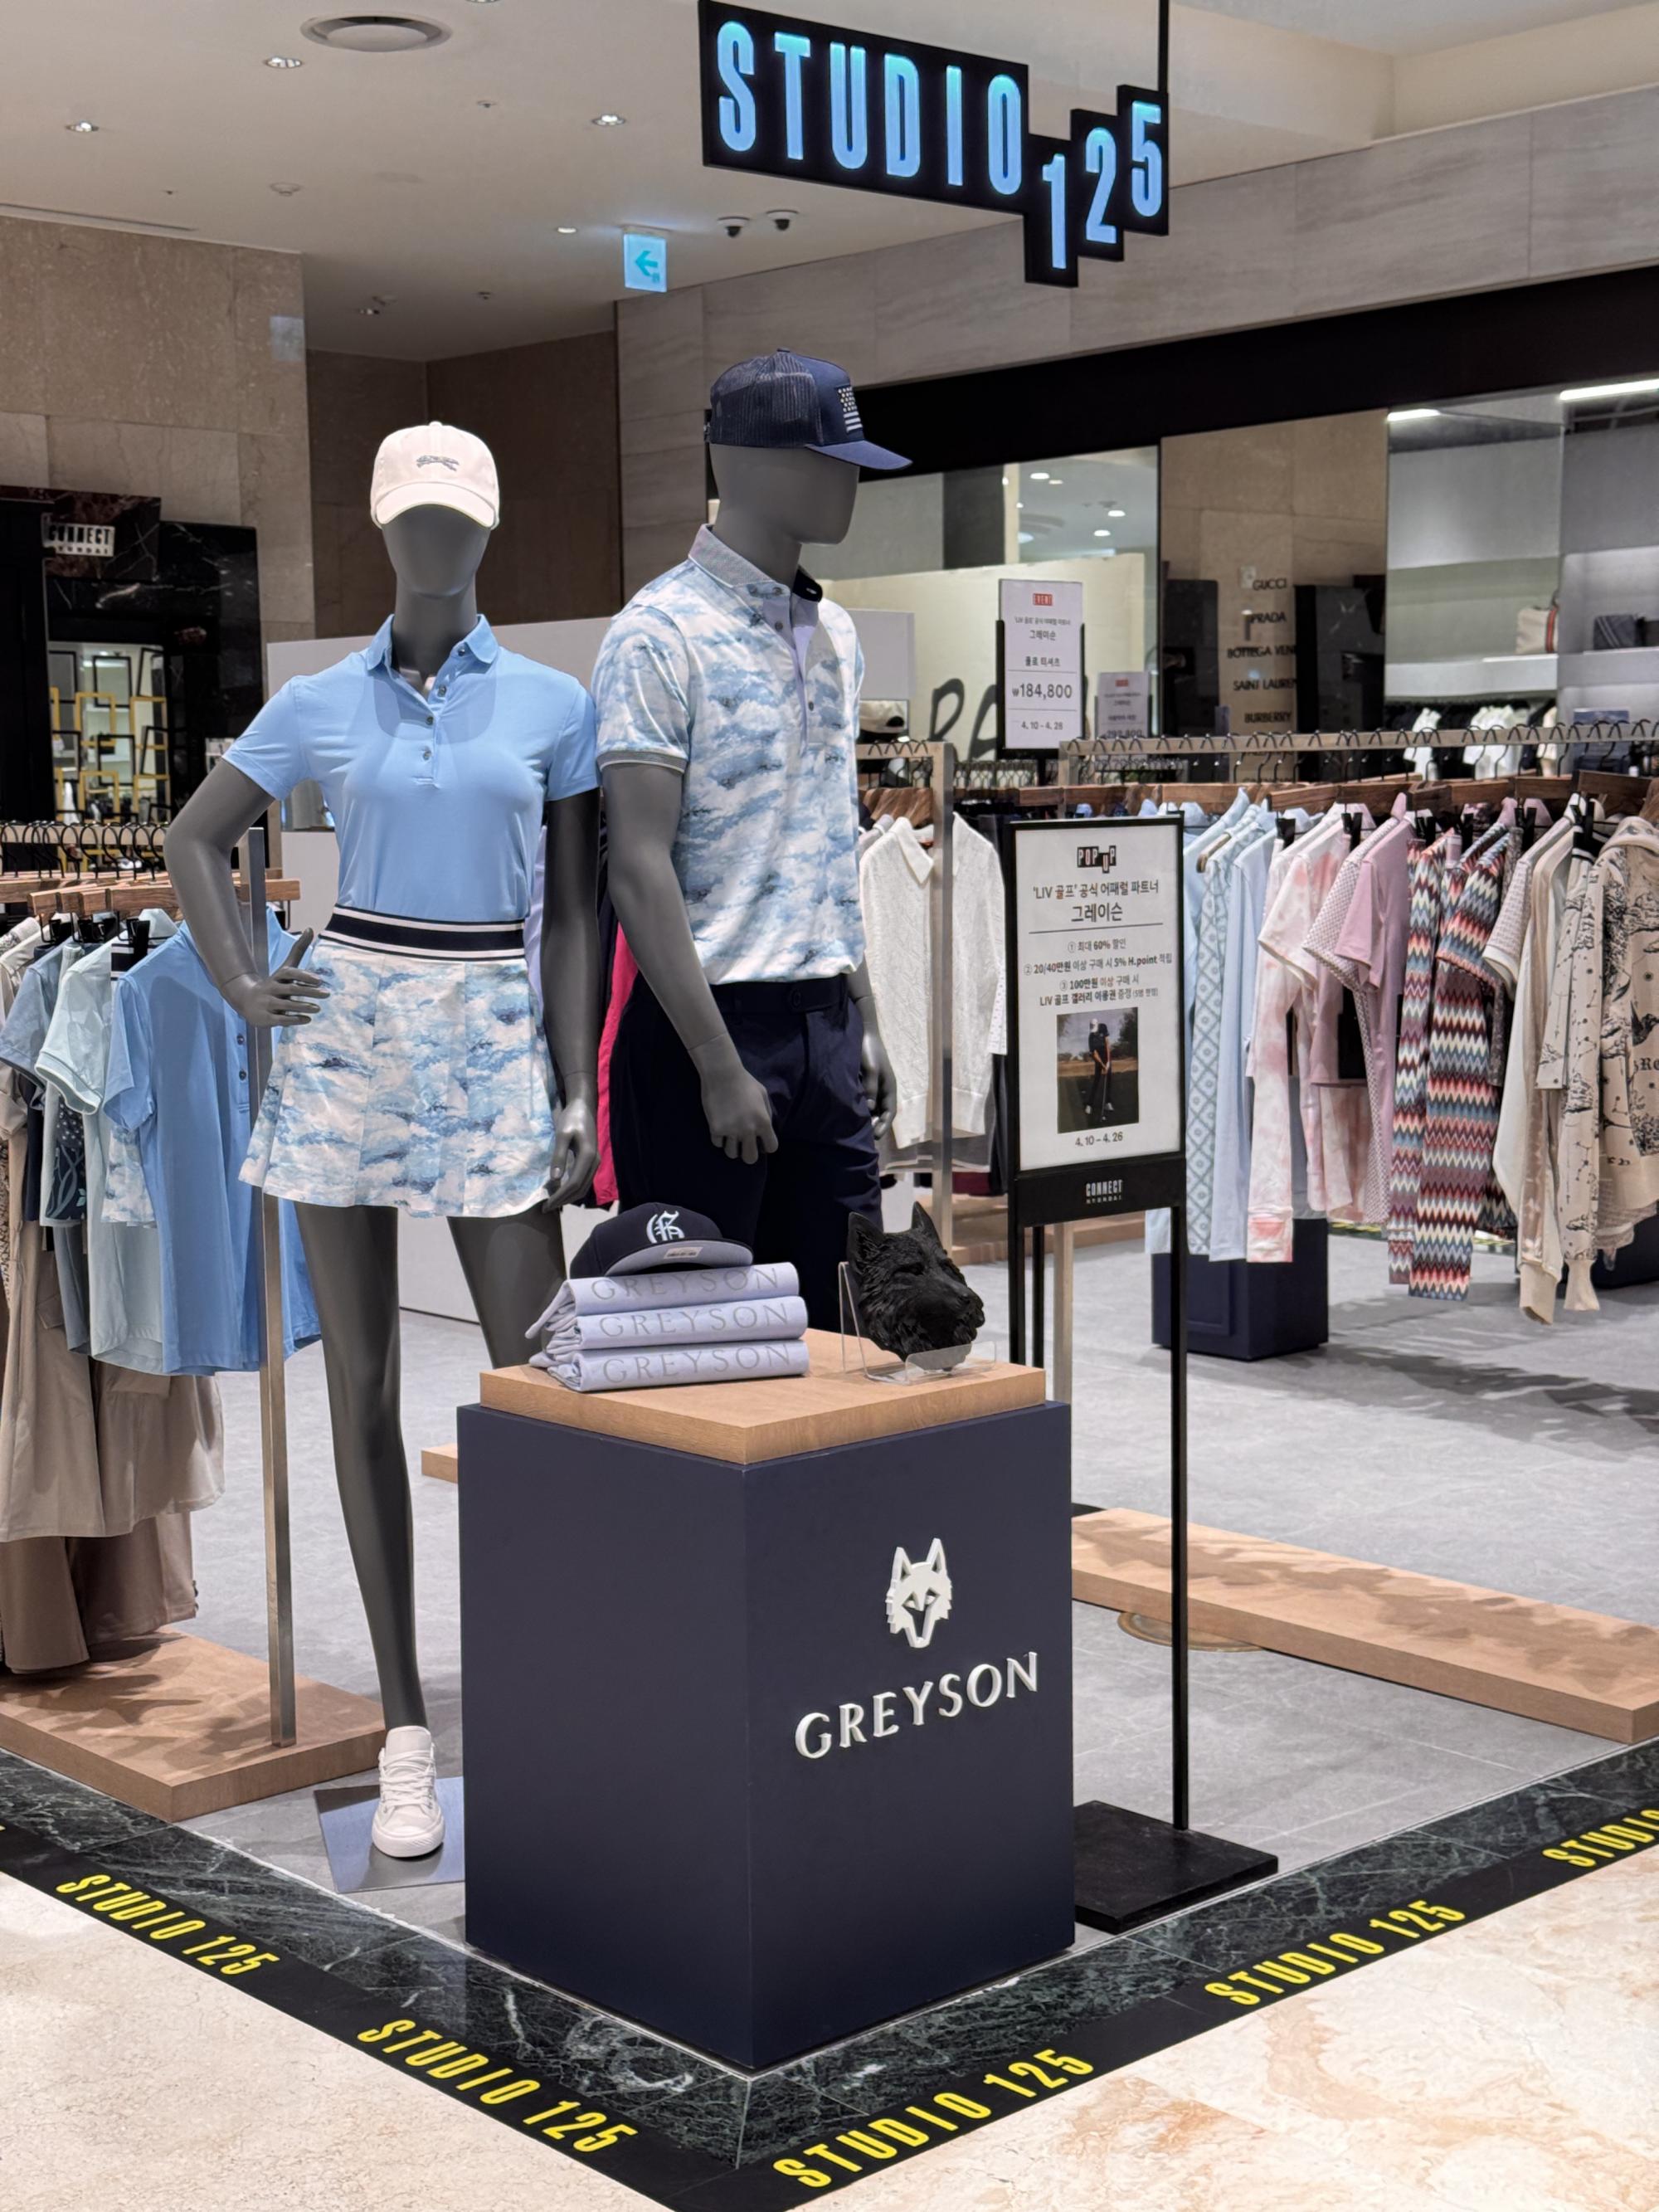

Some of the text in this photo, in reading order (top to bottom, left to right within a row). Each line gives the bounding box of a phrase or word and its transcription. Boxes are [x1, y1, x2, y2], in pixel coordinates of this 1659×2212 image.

[716, 21, 1162, 270] STUDIO 125
[1253, 577, 1287, 591] GUCCI
[1250, 611, 1287, 623] PRADA
[1228, 646, 1272, 659] BOTTEGA
[1233, 679, 1259, 691] SAINT
[1245, 711, 1292, 724] BURBERRY
[1078, 848, 1097, 865] POP
[1079, 882, 1098, 899] 공식
[1100, 881, 1129, 897] 어패럴
[1131, 879, 1159, 894] 파트너
[1071, 902, 1123, 923] 그레이슨
[1078, 942, 1092, 952] 최대
[1093, 940, 1111, 951] 60%
[1112, 938, 1126, 950] 할인
[1073, 959, 1087, 972] 이상
[1088, 957, 1104, 970] 구매
[1106, 957, 1113, 968] 시
[1114, 956, 1127, 967] 5%
[1128, 954, 1157, 967] H.point
[1070, 977, 1098, 990] 100만원
[1100, 977, 1114, 987] 이상
[1116, 975, 1130, 987] 구매
[1131, 974, 1140, 985] 시
[1039, 996, 1053, 1006] LIV
[1054, 994, 1069, 1006] 골프
[1117, 989, 1131, 1001] 증정
[1085, 1135, 1094, 1146] 10
[1112, 1131, 1123, 1142] 26
[1086, 1179, 1122, 1196] CONNECT
[591, 1267, 778, 1300] GREYSON
[600, 1303, 788, 1337] GREYSON
[603, 1344, 791, 1383] GREYSON
[795, 1651, 1037, 1759] GREYSON
[56, 1874, 280, 1976] STUDIO 125
[1204, 1899, 1466, 2006] STUDIO 125
[357, 2020, 639, 2152] STUDIO 125
[772, 2049, 1094, 2188] STUDIO 125
